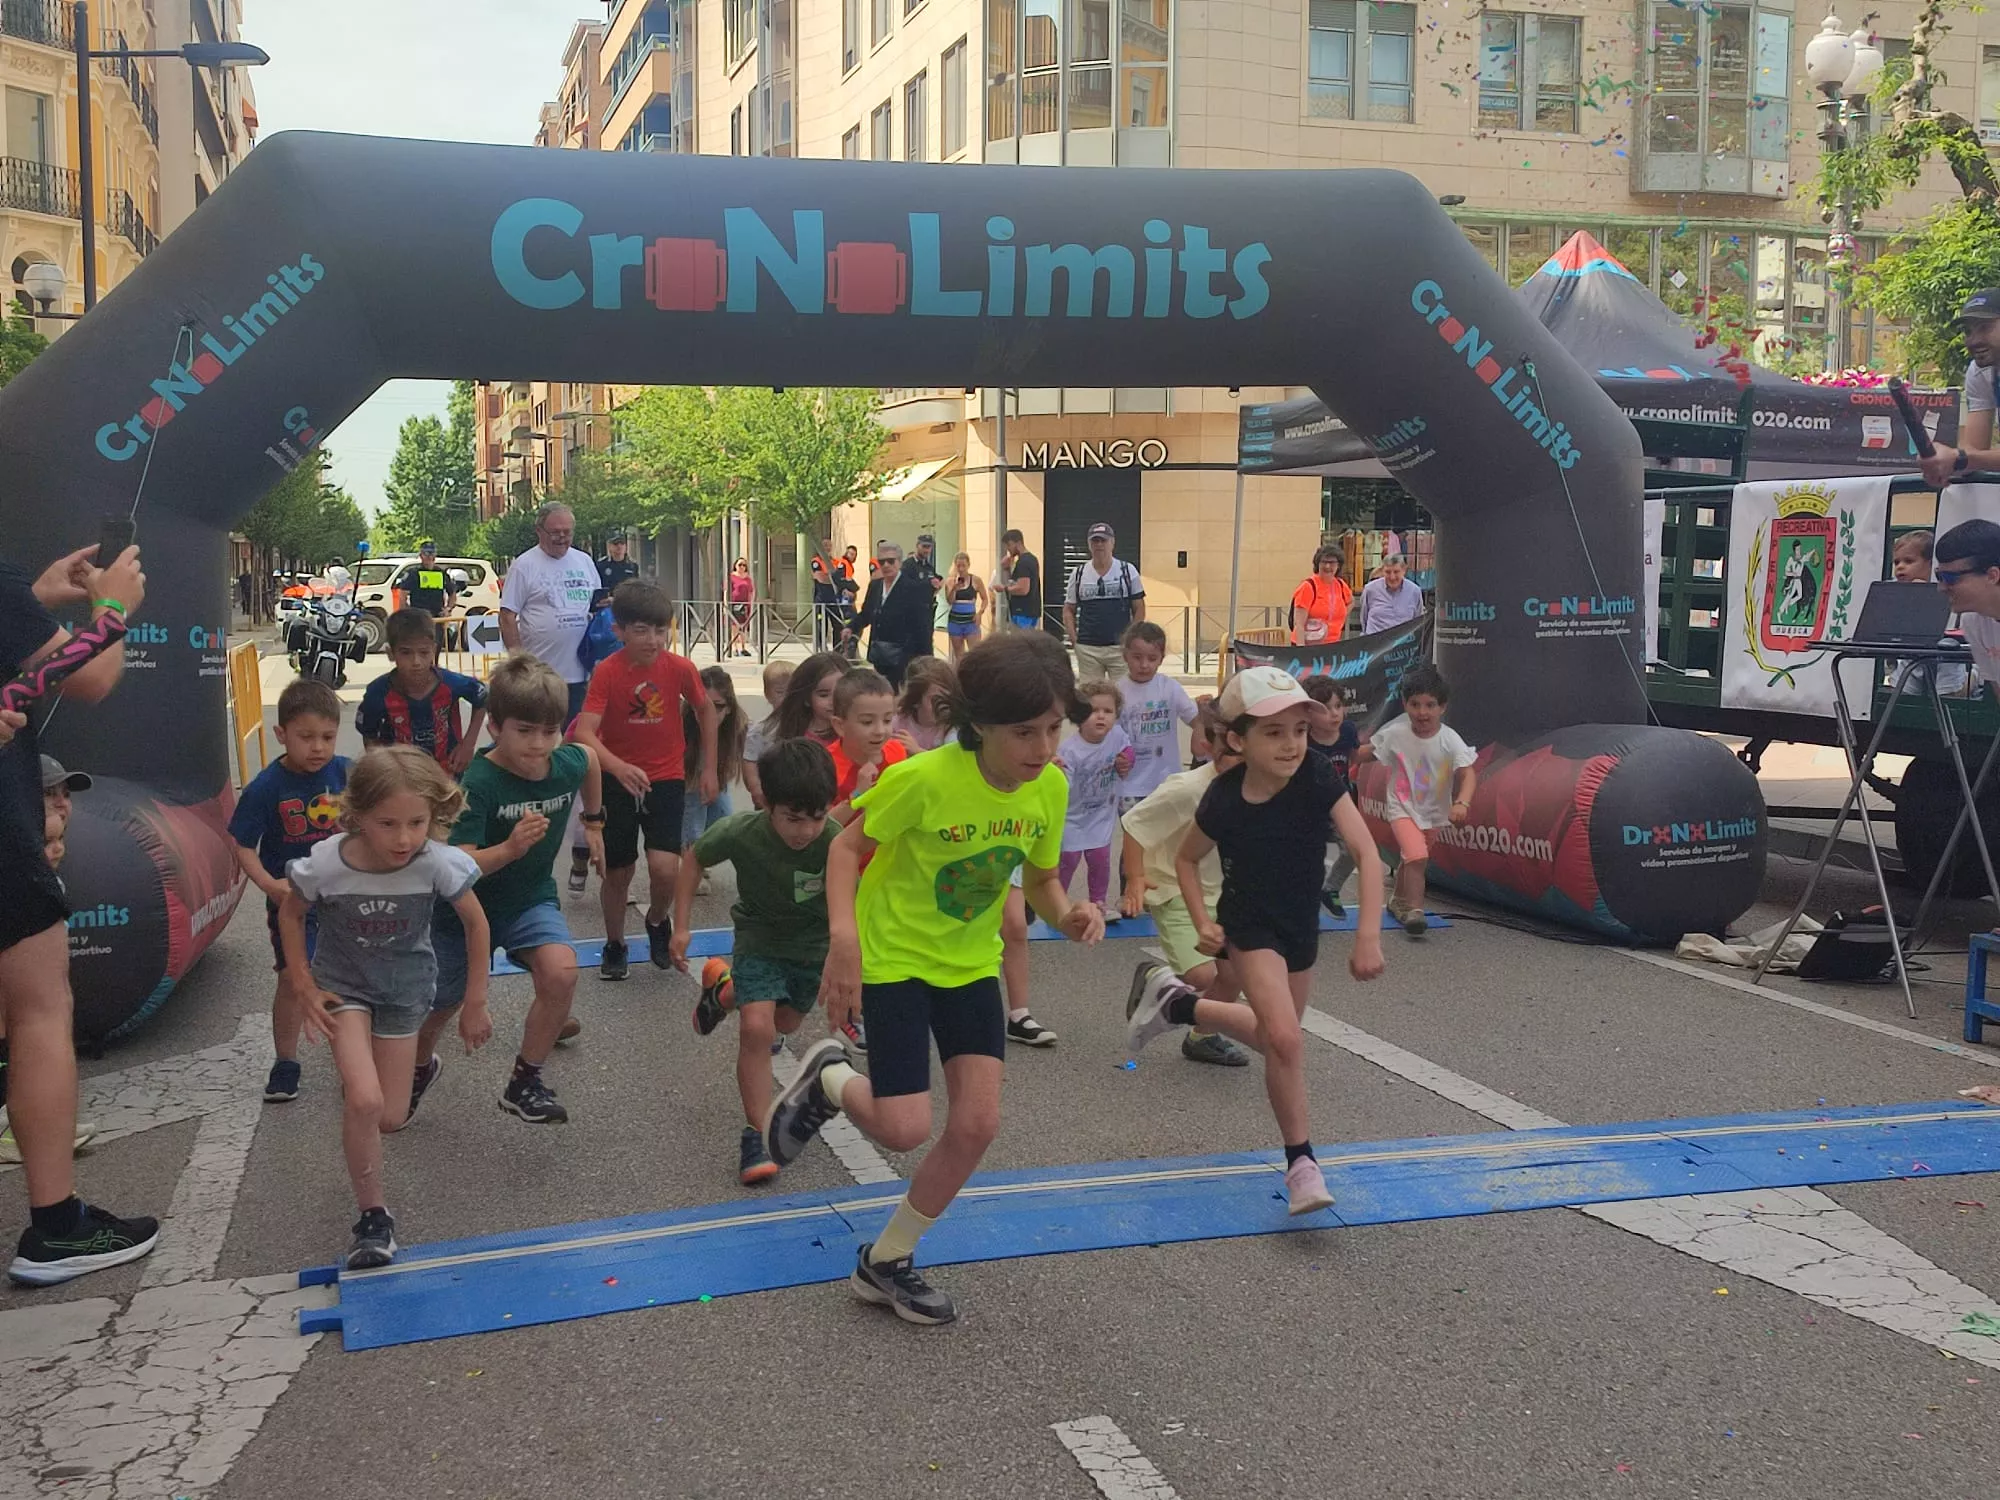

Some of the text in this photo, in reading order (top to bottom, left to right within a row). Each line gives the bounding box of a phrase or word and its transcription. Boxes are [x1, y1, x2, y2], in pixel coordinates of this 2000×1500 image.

[1927, 395, 1953, 407] LIVE
[1021, 438, 1169, 470] MANGO
[1776, 521, 1832, 534] RECREATIVA
[496, 792, 573, 820] MINECRAFT
[939, 823, 977, 842] CEIP
[982, 818, 1024, 842] JUAN
[1659, 847, 1691, 857] Servicio
[1692, 845, 1702, 855] de
[358, 900, 398, 916] GIVE
